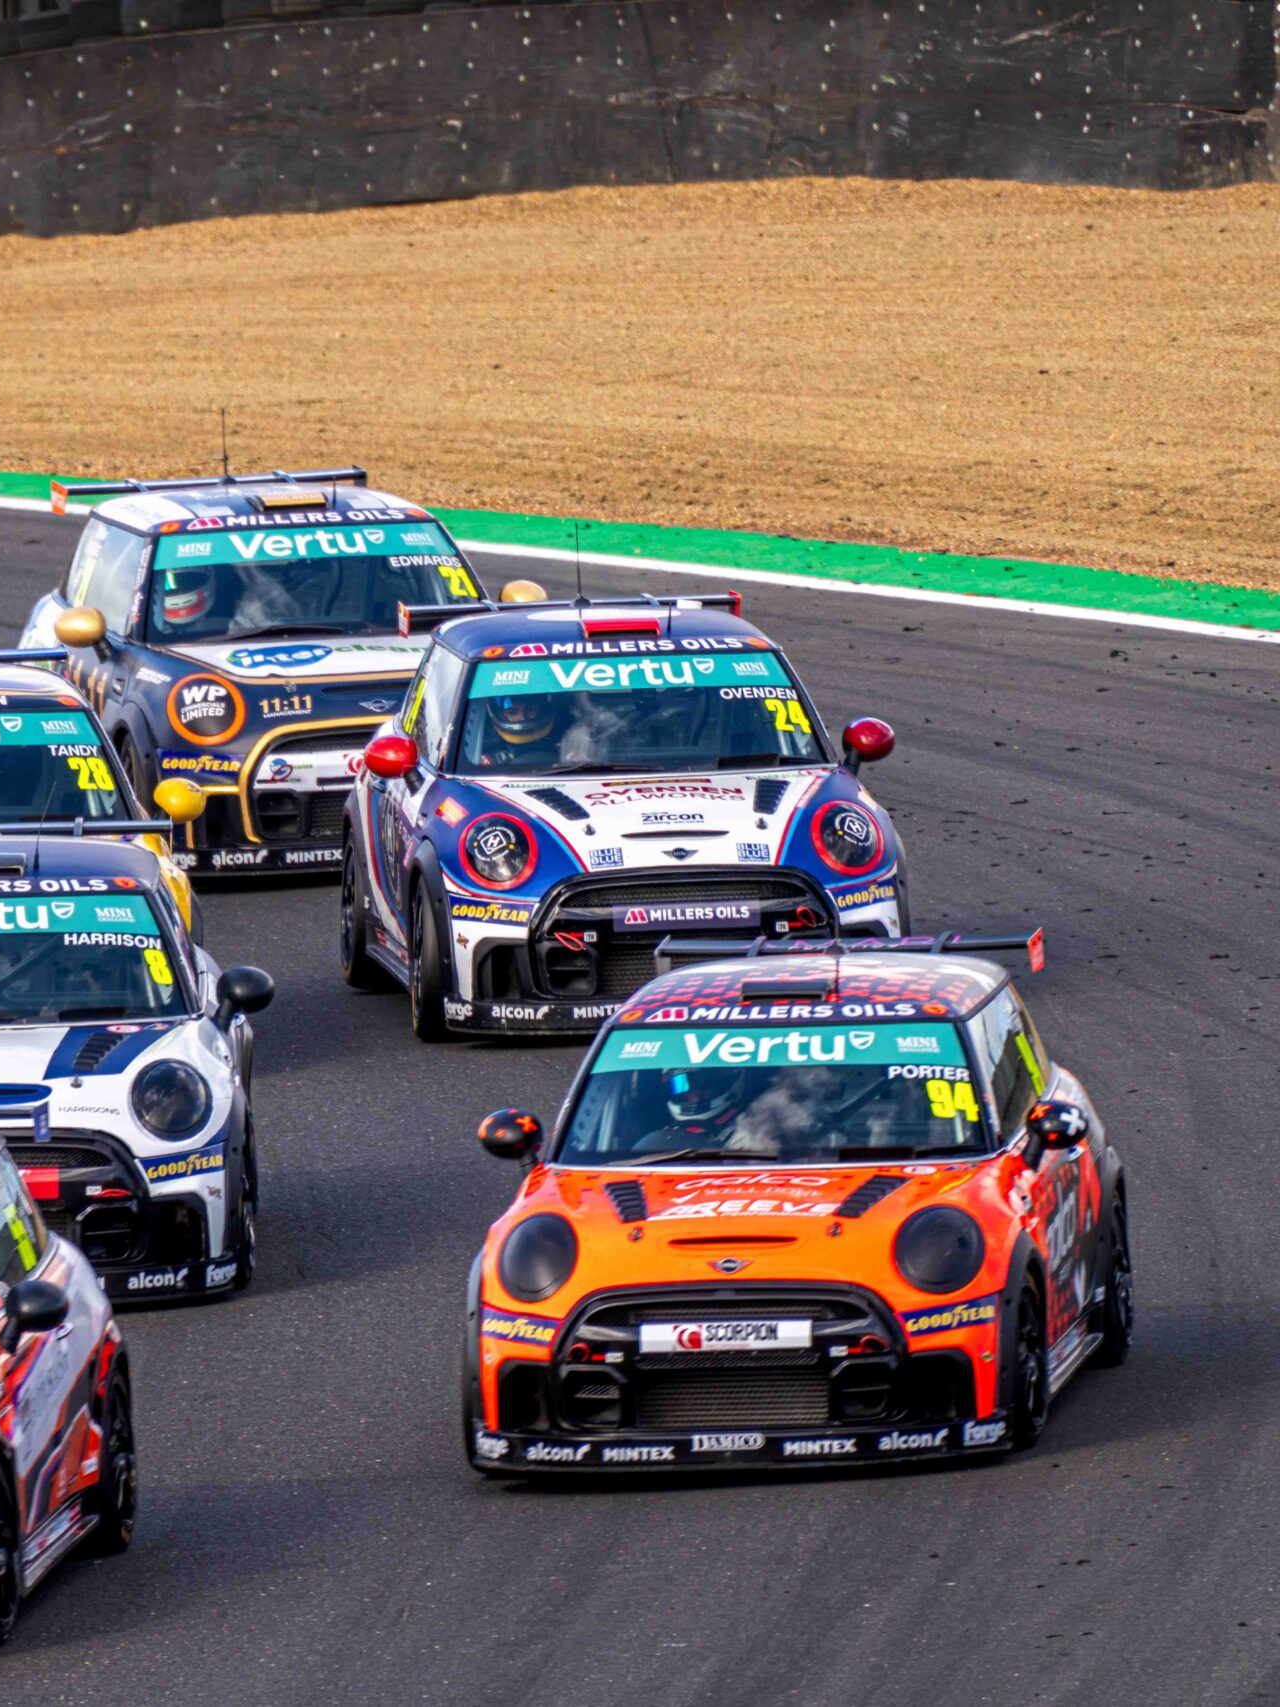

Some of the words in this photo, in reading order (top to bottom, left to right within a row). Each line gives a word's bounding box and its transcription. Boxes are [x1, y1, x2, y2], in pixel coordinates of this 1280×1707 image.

[226, 511, 346, 527] MILLERS
[347, 508, 406, 522] OILS
[228, 530, 367, 560] Vertu
[400, 533, 432, 542] MINI
[177, 542, 211, 552] MINI
[389, 556, 462, 568] EDWARDS
[438, 566, 478, 598] 21
[551, 640, 676, 655] MILLERS
[681, 637, 744, 651] OILS
[549, 658, 695, 689] Vertu
[732, 662, 766, 672] MINI
[495, 671, 531, 681] MINI
[182, 685, 227, 706] WP
[719, 686, 799, 700] OVENDEN
[181, 701, 226, 713] COMMERCIALS
[259, 695, 313, 714] 11:11
[181, 707, 225, 724] LIMITED
[263, 709, 312, 719] MANAGEMENT
[765, 699, 814, 735] 24
[40, 721, 74, 730] MINI
[47, 745, 98, 758] TANDY
[162, 756, 241, 773] GOODYEAR
[67, 757, 115, 791] 28
[584, 786, 745, 799] OVENDEN
[589, 792, 746, 808] ALLWORKS
[641, 812, 704, 822] zircon
[590, 847, 622, 857] BLUE
[737, 843, 770, 851] BLUE
[738, 850, 770, 858] BLUE
[212, 850, 255, 867] alcon
[286, 849, 343, 864] MINTEX
[591, 855, 623, 865] BLUE
[38, 878, 109, 892] OILS
[837, 884, 895, 908] GOODYEAR
[95, 908, 132, 918] MINI
[452, 904, 529, 922] GOODYEAR
[650, 907, 714, 921] MILLERS
[716, 906, 750, 919] OILS
[64, 933, 162, 950] HARRISON
[143, 949, 174, 986] 8
[492, 1005, 535, 1020] alcon
[690, 1005, 834, 1021] MILLERS
[841, 1003, 917, 1019] OILS
[624, 1041, 663, 1052] MINI
[684, 1032, 847, 1065] Vertu
[897, 1037, 937, 1048] MINI
[887, 1065, 971, 1082] PORTER
[925, 1080, 981, 1122] 94
[147, 1153, 224, 1180] GOODYEAR
[128, 1271, 175, 1290] alcon
[206, 1263, 238, 1286] forge
[905, 1304, 995, 1332] GOODYEAR
[482, 1316, 556, 1342] GOODYEAR
[705, 1323, 780, 1342] SCORPION
[691, 1433, 766, 1453] DAMICO
[783, 1438, 858, 1456] MINTEX
[877, 1431, 934, 1451] alcon
[526, 1442, 576, 1462] alcon
[602, 1446, 675, 1462] MINTEX
